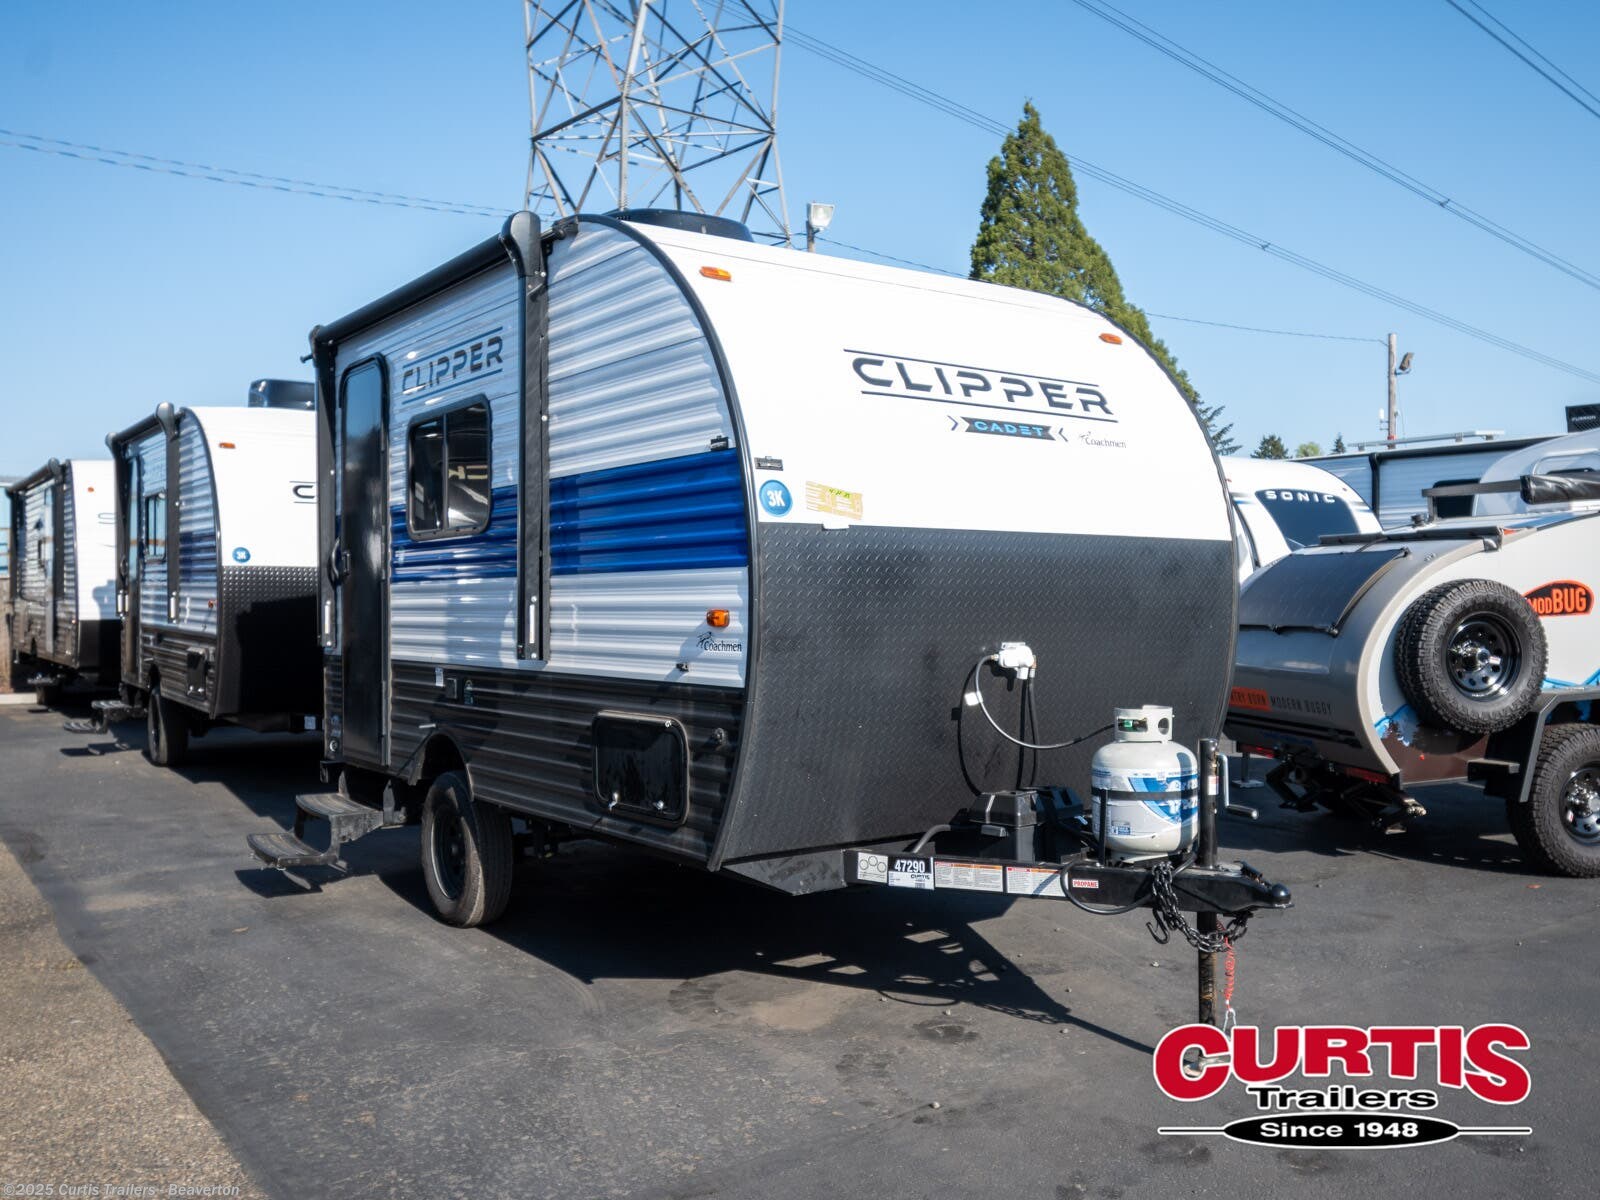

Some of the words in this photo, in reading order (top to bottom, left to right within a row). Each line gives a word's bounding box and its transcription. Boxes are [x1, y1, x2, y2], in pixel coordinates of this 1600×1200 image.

[402, 336, 504, 393] CLIPPER
[852, 357, 1114, 415] CLIPPER
[973, 421, 1044, 437] CADET
[1085, 437, 1127, 448] Coachmen
[766, 490, 786, 507] 3K
[1265, 490, 1336, 503] SONIC
[703, 640, 742, 652] Coachmen
[894, 859, 926, 873] 47290
[1073, 880, 1098, 888] PROPANE
